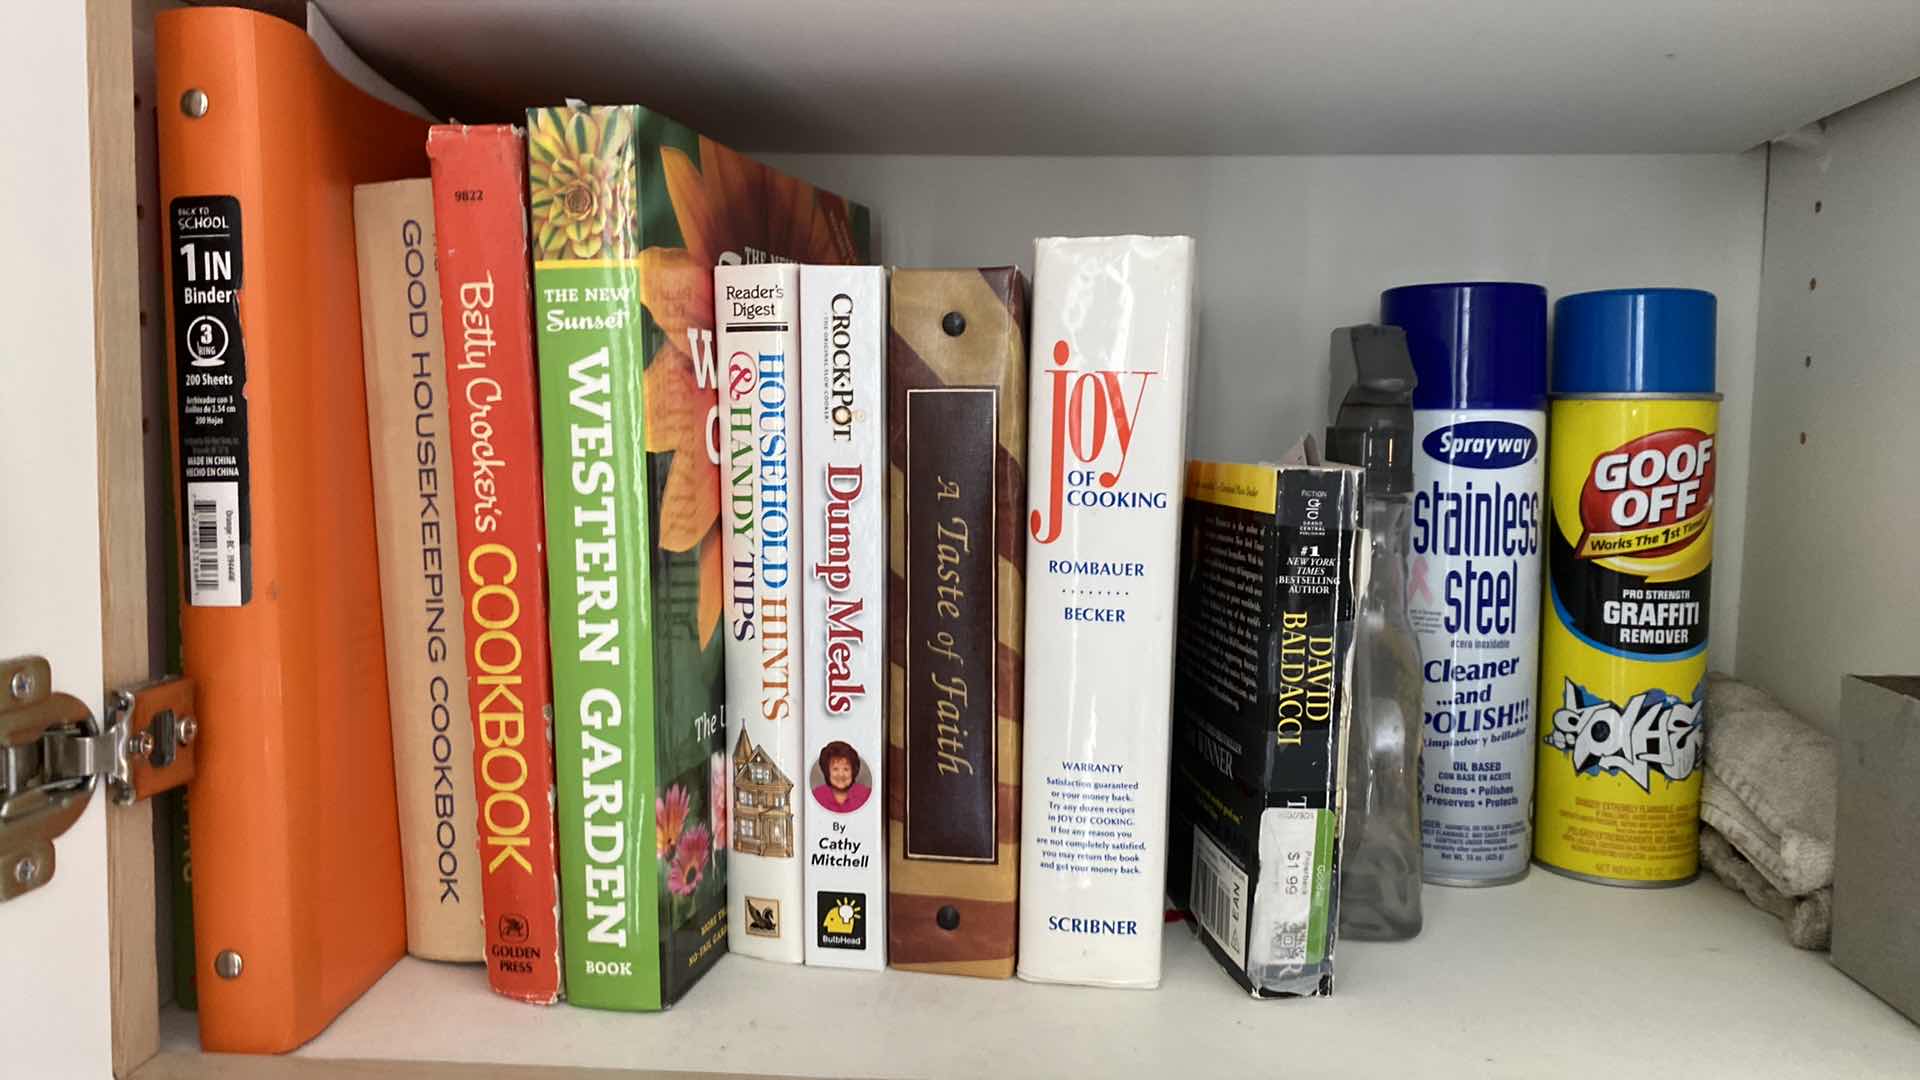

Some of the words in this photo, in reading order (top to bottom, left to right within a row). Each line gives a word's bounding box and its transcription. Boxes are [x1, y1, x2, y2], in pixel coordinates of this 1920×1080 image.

[454, 190, 484, 201] 9822
[178, 216, 229, 230] SCHOOL
[180, 243, 196, 281] 1
[204, 251, 231, 280] IN
[402, 219, 429, 338] GOOD
[184, 286, 232, 304] Binder
[544, 288, 578, 302] THE
[585, 288, 630, 302] NEW
[726, 285, 784, 300] Reader's
[733, 302, 776, 319] Digest
[457, 269, 497, 370] Betty
[546, 308, 630, 332] Sunset
[201, 324, 213, 344] 3
[186, 374, 201, 386] 200
[202, 374, 233, 386] Sheets
[729, 351, 760, 401] &
[1030, 340, 1159, 544] joy
[1439, 431, 1531, 459] Sprayway
[188, 456, 203, 466] MADE
[205, 456, 213, 465] IN
[214, 456, 236, 465] CHINA
[465, 377, 506, 533] Crocker's
[217, 466, 239, 476] CHINA
[758, 352, 790, 589] HOUSEHOLD
[1595, 438, 1713, 491] GOOF
[730, 406, 755, 547] HANDY
[1067, 471, 1096, 486] OF
[937, 476, 961, 501] A
[1301, 489, 1328, 497] FICTION
[411, 351, 448, 663] HOUSEKEEPING
[568, 346, 620, 666] WESTERN
[1067, 490, 1168, 509] COOKING
[1611, 480, 1700, 527] OFF
[817, 462, 863, 590] Dump
[1413, 481, 1538, 556] stainless
[1591, 538, 1632, 551] Works
[1636, 534, 1660, 546] The
[1661, 528, 1680, 544] 1st
[1301, 545, 1321, 557] #1
[937, 517, 970, 618] Taste
[1049, 560, 1144, 576] ROMBAUER
[1287, 557, 1309, 567] NEW
[1311, 558, 1337, 567] YORK
[1297, 567, 1326, 575] TIMES
[1279, 575, 1340, 585] BESTSELLING
[733, 552, 756, 642] TIPS
[1288, 586, 1330, 594] AUTHOR
[1444, 560, 1518, 634] steel
[1623, 589, 1643, 599] PRO
[1645, 589, 1690, 599] STRENGTH
[1064, 607, 1125, 622] BECKER
[1603, 600, 1700, 626] GRAFFITI
[1620, 628, 1689, 643] REMOVER
[927, 630, 964, 664] of
[761, 596, 790, 721] HINTS
[827, 597, 865, 715] Meals
[1277, 610, 1308, 746] BALDACCI
[1306, 635, 1333, 721] DAVID
[1424, 657, 1520, 683] Cleaner
[467, 543, 533, 874] COOKBOOK
[695, 711, 717, 743] The
[932, 673, 974, 776] Faith
[1062, 761, 1123, 774] WARRANTY
[1453, 762, 1468, 771] OIL
[1471, 762, 1501, 771] BASED
[429, 675, 460, 905] COOKBOOK
[1046, 776, 1092, 788] Satisfaction
[1093, 781, 1139, 790] guaranteed
[1434, 784, 1468, 795] Cleans
[1061, 792, 1080, 801] your
[1082, 794, 1109, 803] money
[1426, 794, 1475, 807] Preserves
[1049, 801, 1061, 810] Try
[1063, 804, 1077, 812] any
[1079, 803, 1104, 813] dozen
[1106, 806, 1135, 815] recipes
[579, 687, 627, 948] GARDEN
[1057, 814, 1073, 824] JOY
[1075, 816, 1087, 824] OF
[832, 822, 846, 834] By
[1058, 826, 1070, 834] for
[1071, 829, 1086, 838] any
[1117, 832, 1132, 840] you
[818, 837, 861, 854] Cathy
[1065, 840, 1110, 851] completely
[811, 853, 869, 868] Mitchell
[1058, 852, 1075, 860] may
[1077, 853, 1102, 861] return
[1104, 853, 1118, 861] the
[1119, 853, 1140, 862] book
[1040, 861, 1055, 869] and
[1056, 863, 1069, 872] get
[1070, 864, 1089, 873] your
[1090, 866, 1118, 875] money
[1049, 916, 1138, 935] SCRIBNER
[822, 934, 861, 945] BulbHead
[492, 944, 541, 959] GOLDEN
[500, 960, 533, 973] PRESS
[585, 960, 632, 976] BOOK
